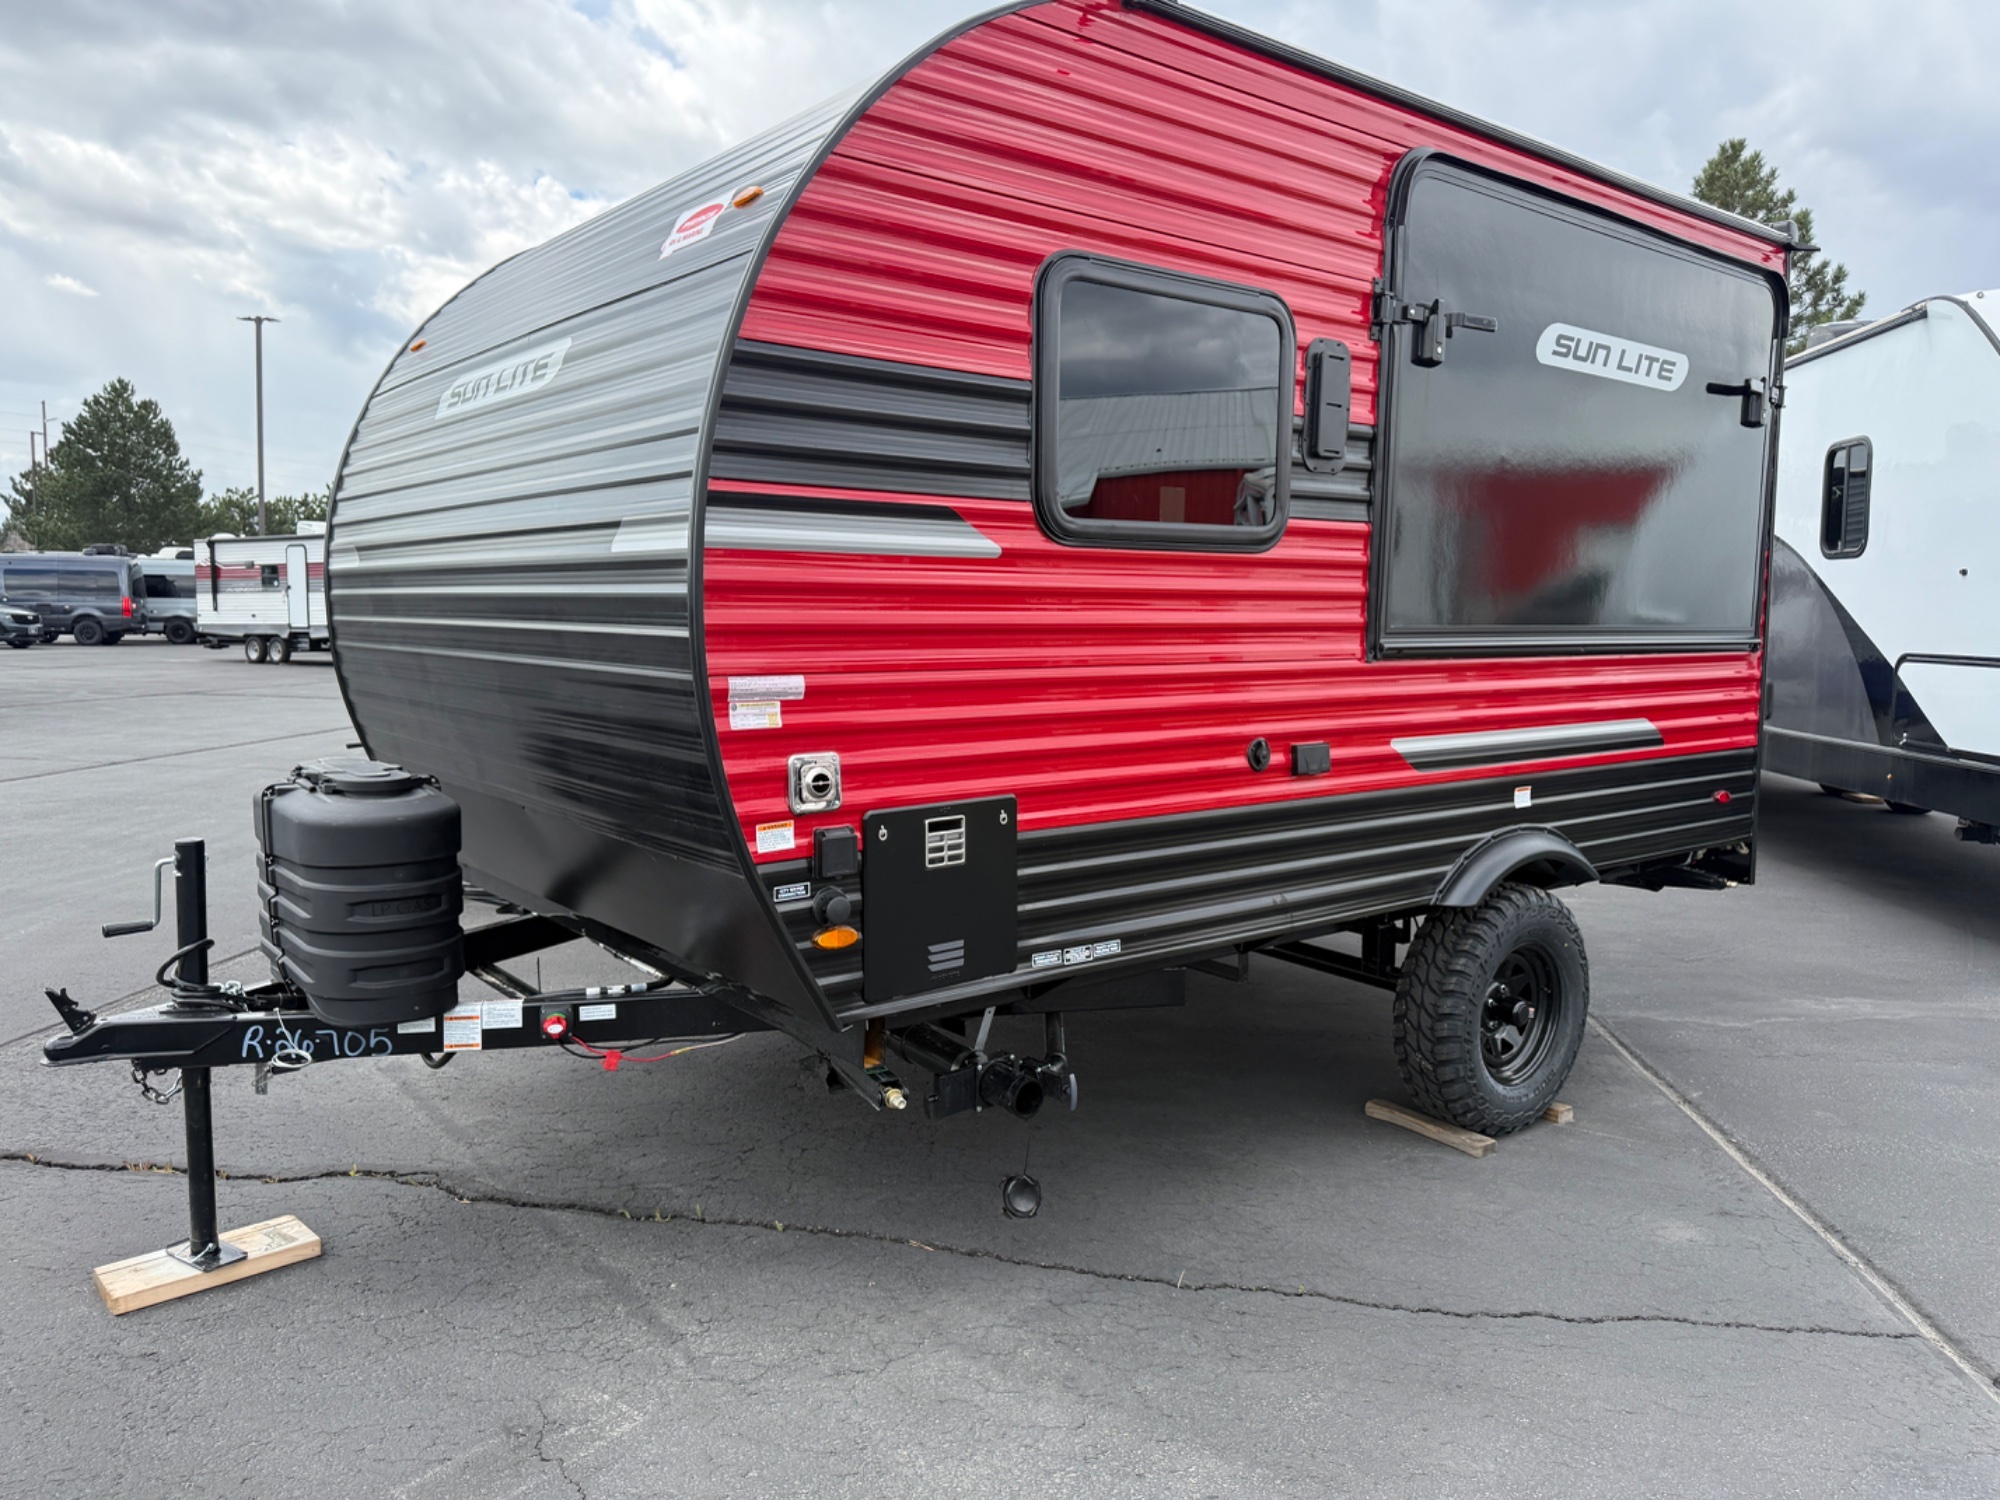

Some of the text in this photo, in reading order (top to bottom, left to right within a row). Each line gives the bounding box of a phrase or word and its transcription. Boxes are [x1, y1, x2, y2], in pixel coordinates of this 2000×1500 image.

[447, 351, 556, 409] SUN LITE
[1551, 333, 1677, 382] SUN LITE
[372, 903, 391, 917] LP
